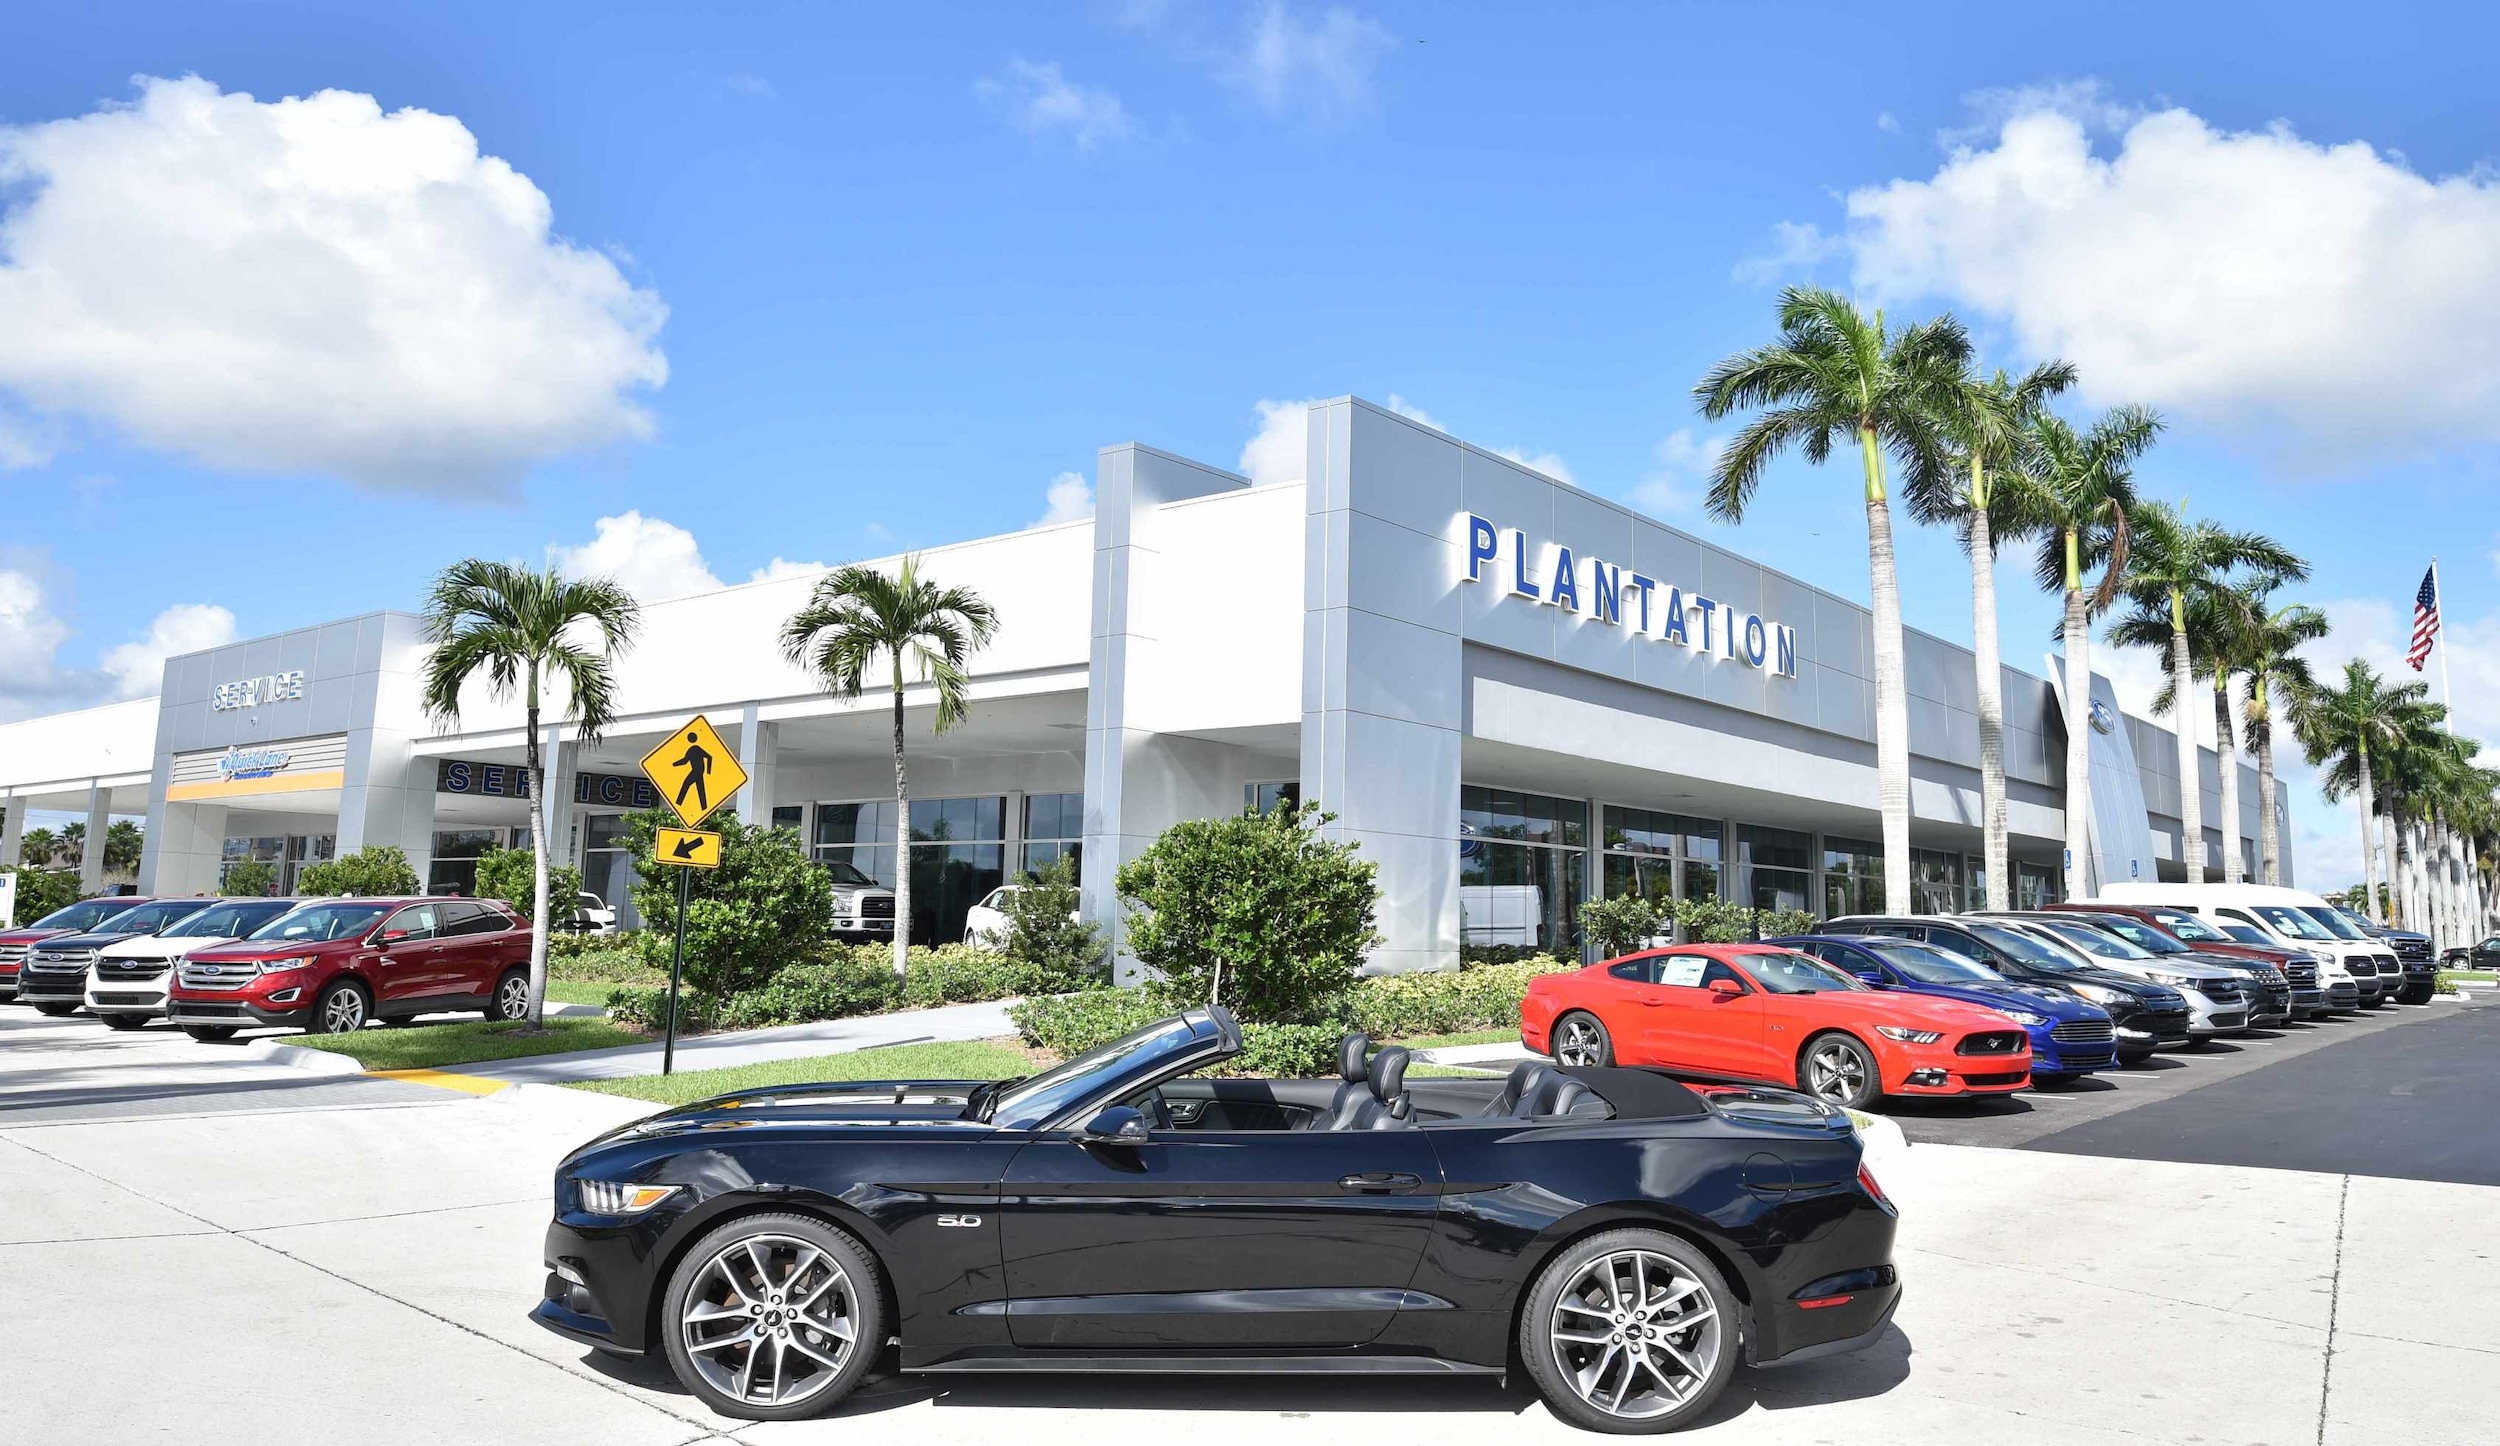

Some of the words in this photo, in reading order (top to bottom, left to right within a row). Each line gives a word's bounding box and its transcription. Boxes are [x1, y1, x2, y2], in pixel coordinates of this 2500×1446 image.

[1463, 512, 1796, 678] PLANTATION
[213, 671, 303, 710] SERVICE
[446, 762, 651, 806] SERICE
